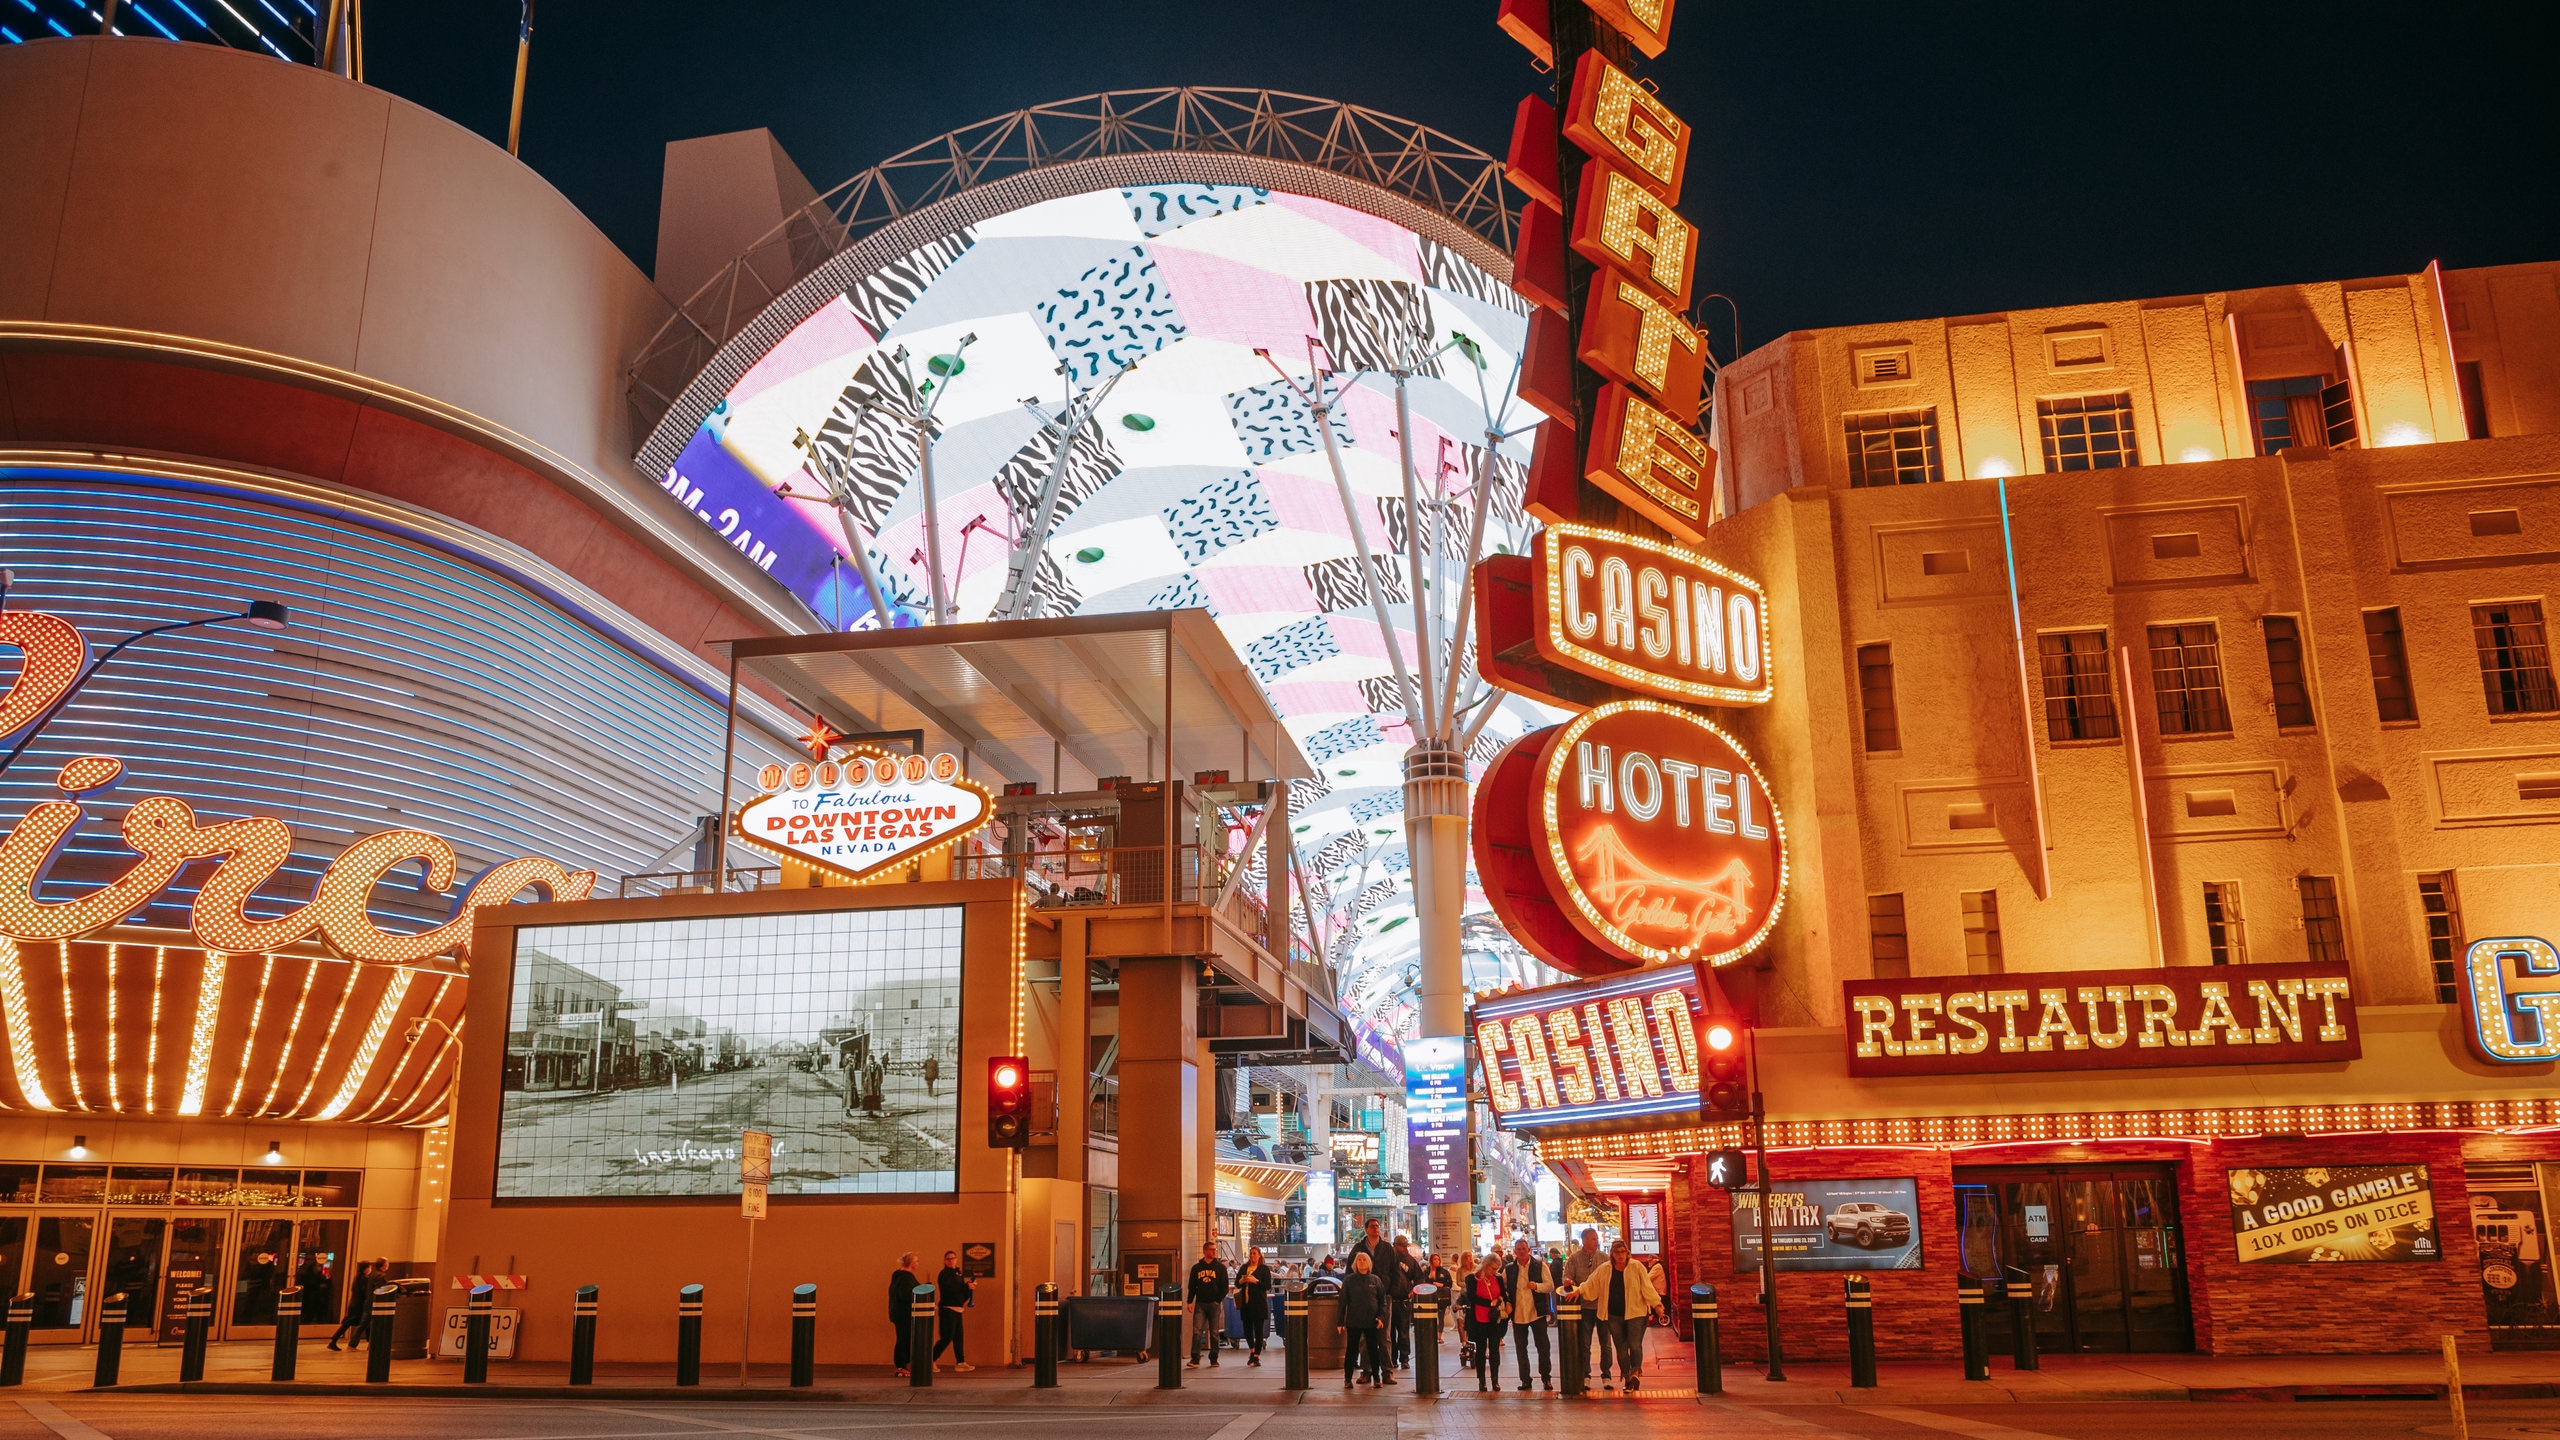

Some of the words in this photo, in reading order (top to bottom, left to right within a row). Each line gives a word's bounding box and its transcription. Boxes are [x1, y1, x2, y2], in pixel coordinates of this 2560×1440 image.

[1595, 64, 1707, 521] GATE
[1564, 546, 1760, 682] CASINO
[760, 755, 955, 790] WELCOME
[792, 798, 809, 810] TO
[814, 790, 916, 812] Fabulous
[1578, 741, 1768, 840] HOTEL
[767, 805, 956, 831] DOWNTOWN
[787, 828, 834, 845] LAS
[844, 822, 933, 841] VEGAS
[822, 842, 896, 855] NEVADA
[1613, 887, 1689, 932] Golden
[1694, 901, 1739, 936] Gate
[1853, 976, 2349, 1057] RESTAURANT
[1478, 989, 1700, 1112] CASINO
[748, 1203, 760, 1212] FINE
[1738, 1193, 1760, 1208] WIN
[1769, 1193, 1805, 1207] EREK'S
[2242, 1210, 2259, 1231] A
[2263, 1194, 2325, 1225] GOOD
[2331, 1172, 2419, 1209] GAMBLE
[1790, 1205, 1820, 1226] TRX
[2028, 1215, 2047, 1223] ATM
[2251, 1231, 2286, 1252] 10X
[2292, 1222, 2339, 1242] ODDS
[2344, 1212, 2369, 1231] ON
[2375, 1200, 2420, 1223] DICE
[1198, 1270, 1216, 1279] IOWA
[449, 1315, 512, 1330] CLED
[455, 1335, 498, 1350] RD
